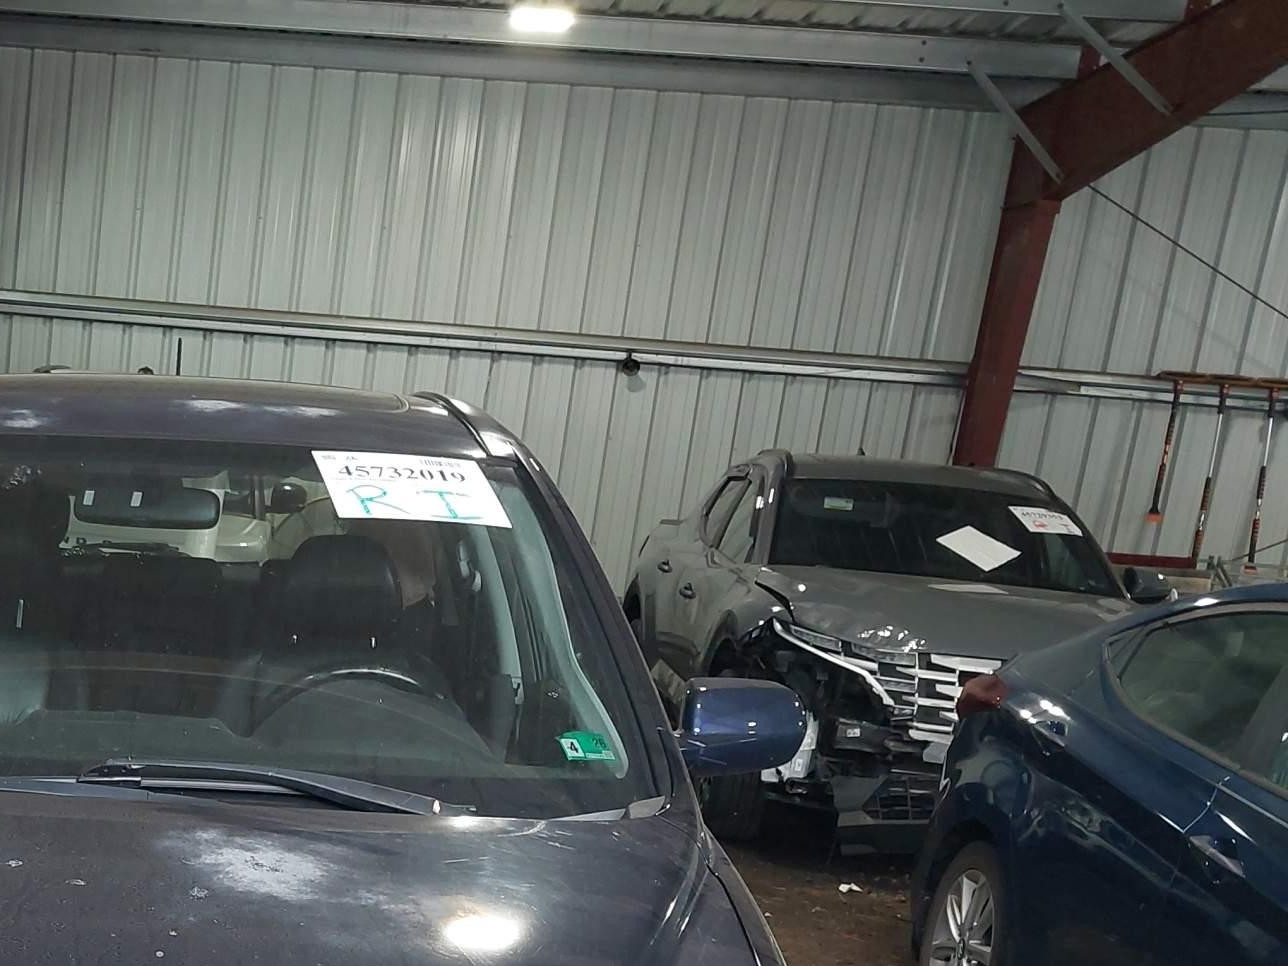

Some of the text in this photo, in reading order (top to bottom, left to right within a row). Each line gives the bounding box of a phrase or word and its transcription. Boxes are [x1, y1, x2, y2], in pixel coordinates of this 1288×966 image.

[338, 464, 466, 483] 45732019
[346, 484, 411, 515] R
[567, 741, 579, 754] 4
